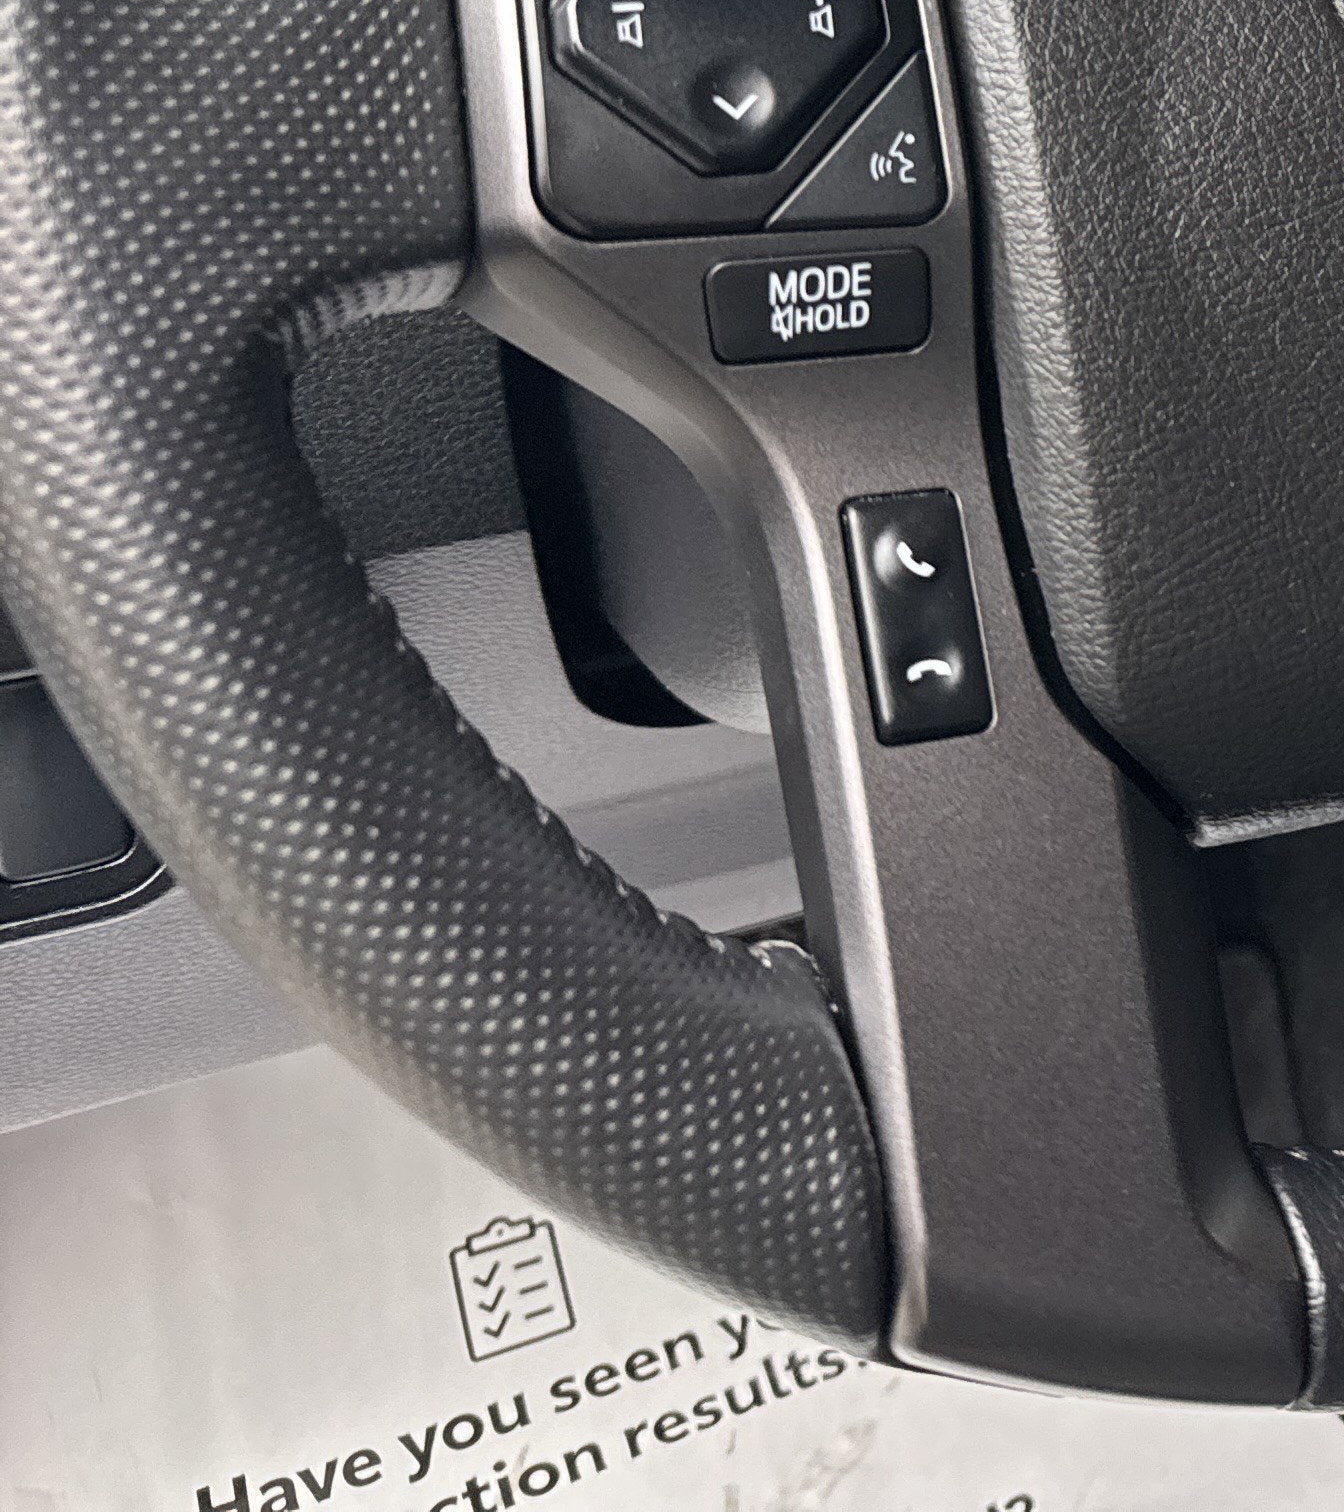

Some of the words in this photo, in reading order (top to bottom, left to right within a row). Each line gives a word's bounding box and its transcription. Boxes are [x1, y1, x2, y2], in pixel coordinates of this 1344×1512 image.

[769, 262, 872, 306] MODE
[795, 300, 870, 335] HOLD
[196, 1448, 382, 1512] Have
[398, 1392, 531, 1484] you
[550, 1330, 704, 1414] seen
